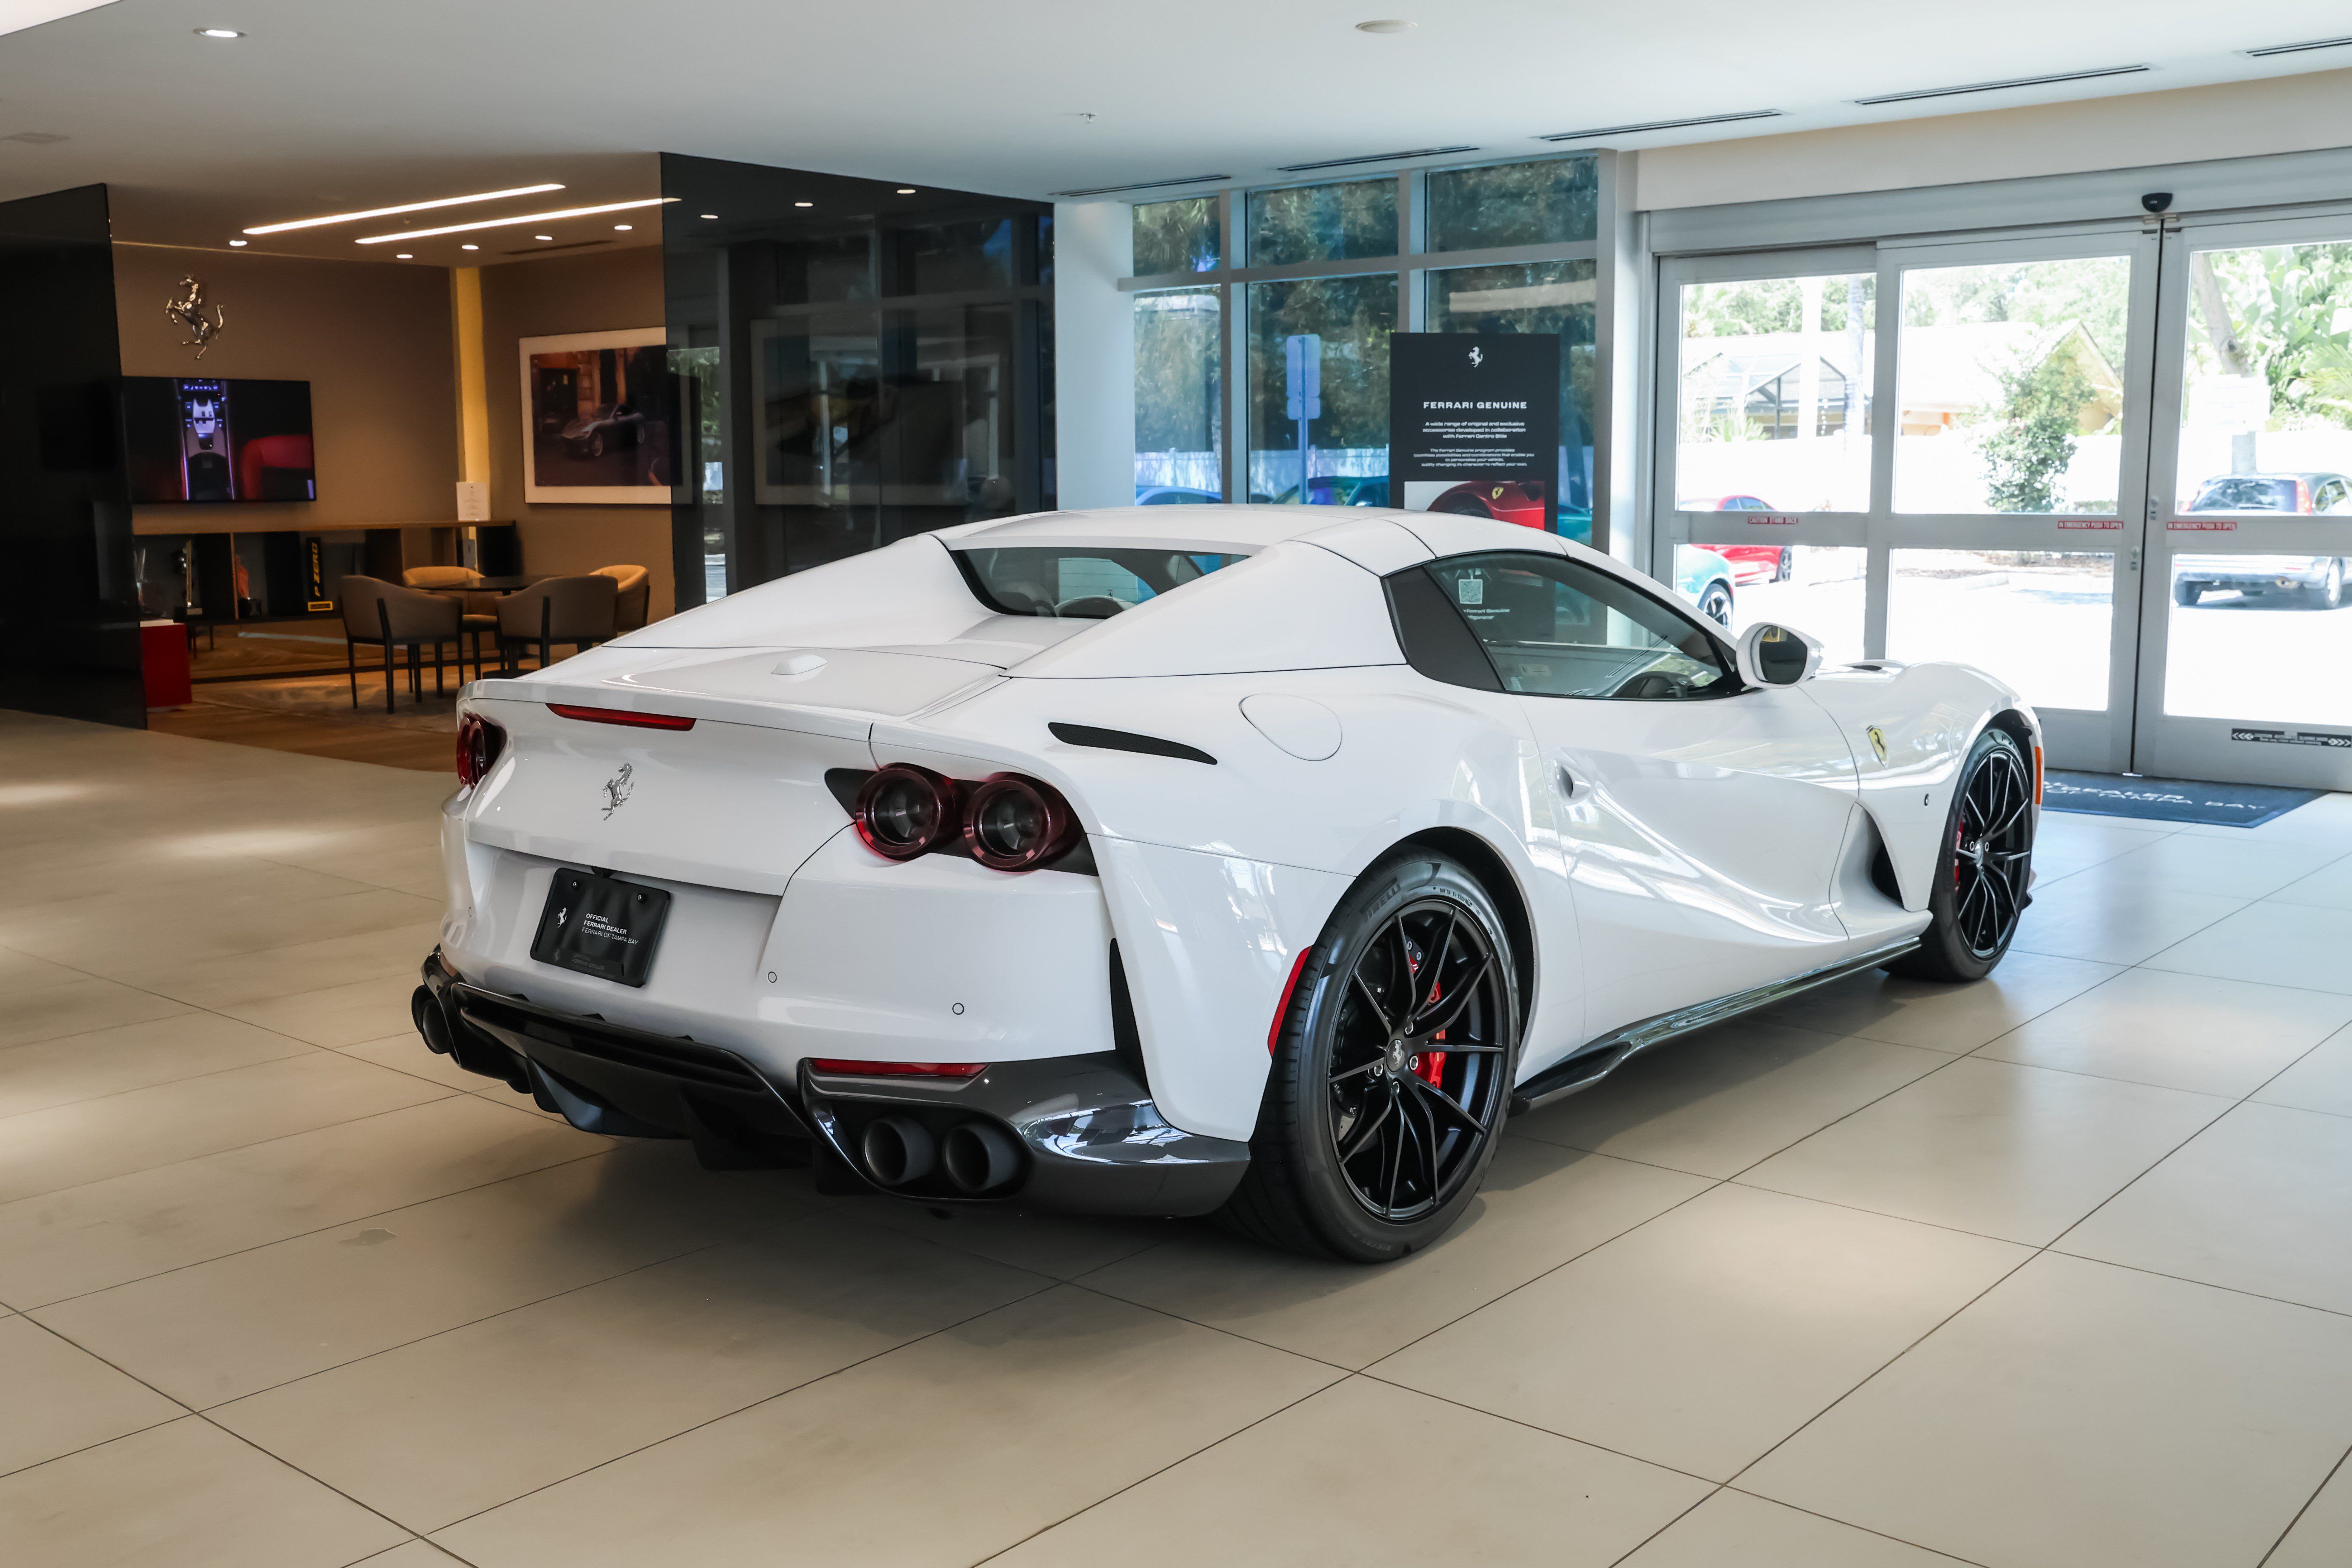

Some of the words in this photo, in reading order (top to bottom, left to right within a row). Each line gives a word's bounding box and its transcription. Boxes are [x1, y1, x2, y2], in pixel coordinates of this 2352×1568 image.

[312, 542, 320, 584] ZERO
[314, 586, 321, 597] P
[1359, 877, 1401, 925] PIRELLI
[586, 913, 609, 923] OFFICIAL
[581, 927, 603, 937] FERRARI
[612, 934, 627, 942] TAMPA
[583, 920, 606, 930] FERRARI
[606, 925, 627, 935] DEALER
